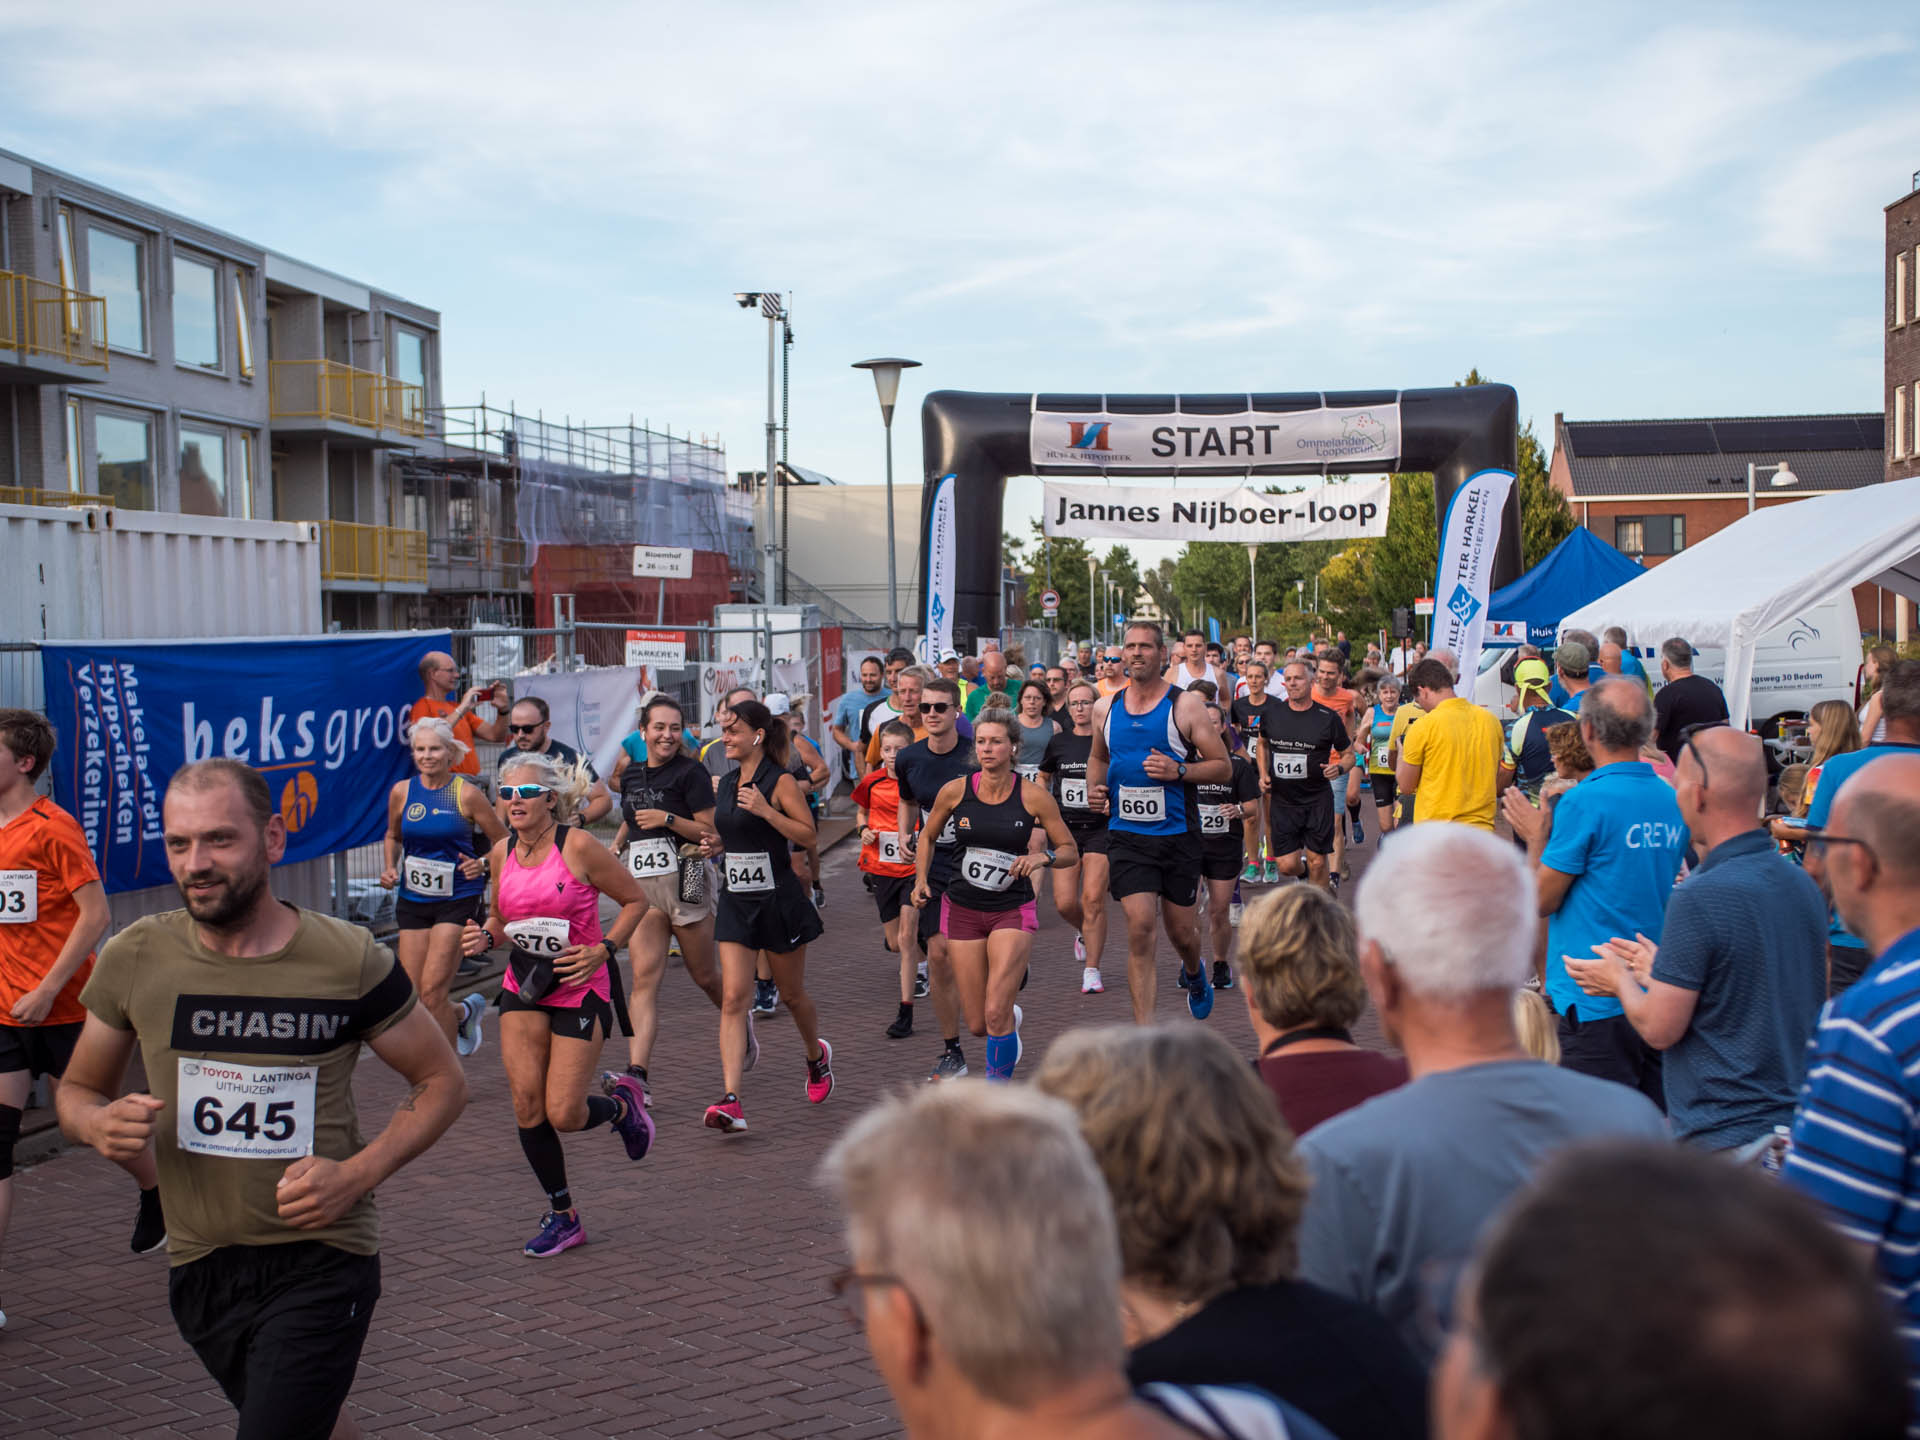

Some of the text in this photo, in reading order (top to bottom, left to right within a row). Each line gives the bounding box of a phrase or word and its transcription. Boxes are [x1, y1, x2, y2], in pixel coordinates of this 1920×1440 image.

[1152, 425, 1280, 457] START
[1296, 436, 1366, 449] Ommelander
[1056, 497, 1377, 530] Jannes Nijboer-loop
[1458, 488, 1481, 580] TER HARKEL
[1531, 627, 1554, 638] Huis
[1782, 673, 1792, 681] 30
[1794, 672, 1823, 681] Bedum
[99, 664, 133, 844] Hypotheken
[1277, 762, 1302, 774] 614
[1122, 799, 1158, 815] 660
[1626, 822, 1683, 849] CREW
[634, 851, 670, 871] 643
[410, 870, 444, 889] 631
[729, 866, 766, 885] 644
[968, 861, 1011, 885] 677
[513, 933, 563, 953] 676
[191, 1009, 350, 1041] CHASIN'
[202, 1067, 312, 1083] TOYOTA LANTINGA
[216, 1081, 275, 1095] UITHUIZEN
[193, 1096, 297, 1142] 645
